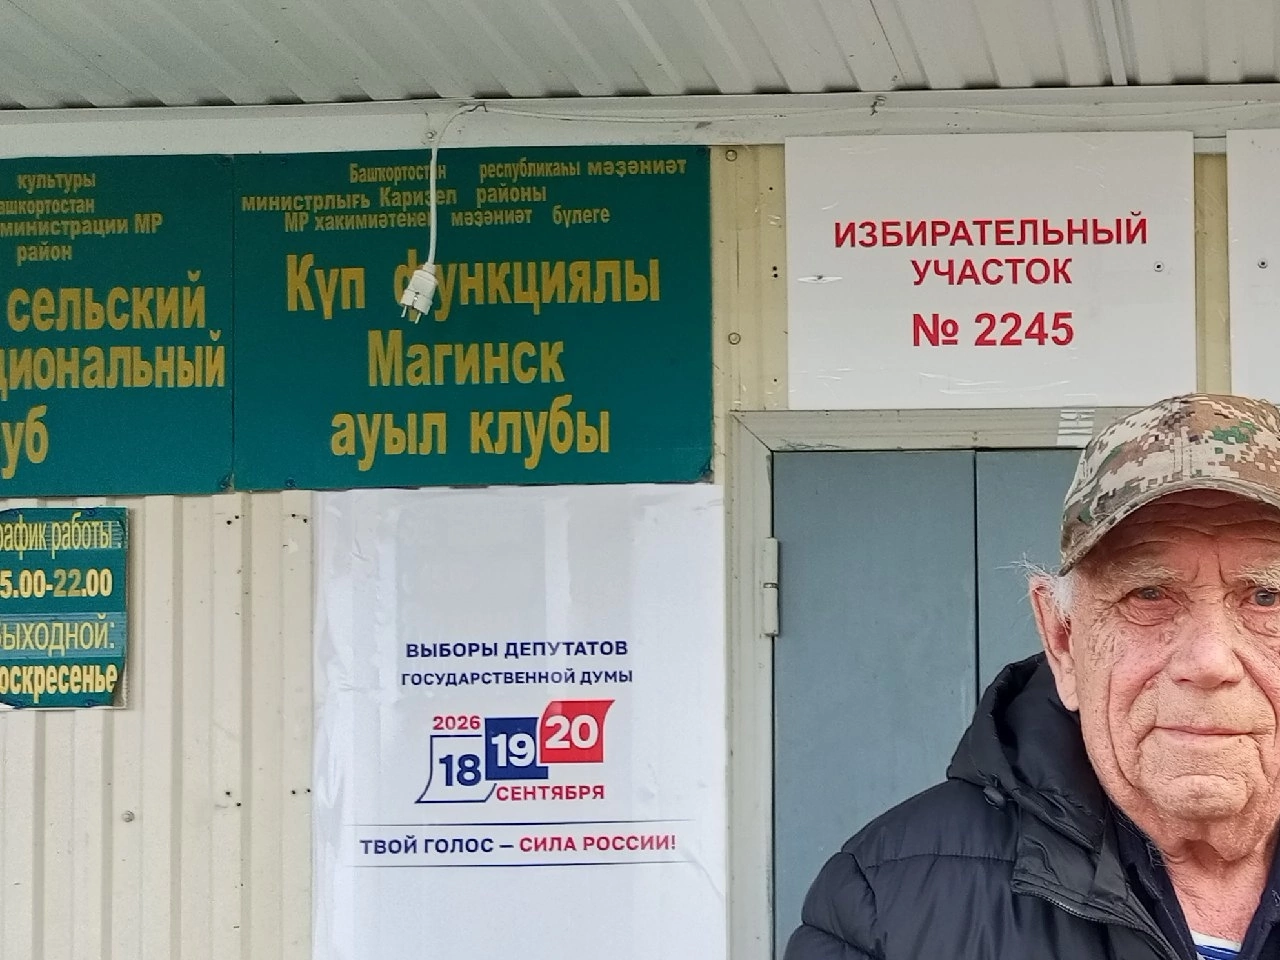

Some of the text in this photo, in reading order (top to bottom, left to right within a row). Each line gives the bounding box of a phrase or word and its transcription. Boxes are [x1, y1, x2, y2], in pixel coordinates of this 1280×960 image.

[18, 172, 96, 194] культуры
[350, 163, 447, 186] Башкортостн
[479, 157, 580, 183] республикаһы
[477, 183, 546, 208] районы
[134, 213, 163, 234] МР
[285, 212, 308, 232] МР
[553, 205, 611, 228] бүлеге
[834, 211, 1148, 248] ИЗБИРАТЕЛЬНЫЙ
[17, 241, 73, 266] район
[286, 254, 365, 320] Күп
[911, 258, 1073, 286] УЧАСТОК
[7, 269, 206, 331] сельский
[912, 312, 1074, 347] № 2245
[368, 330, 564, 387] Магинск
[1, 404, 49, 480] уб
[331, 395, 609, 472] ауыл клубы
[0, 514, 47, 560] афик
[0, 568, 113, 599] 5.00-22.00
[406, 641, 628, 659] ВЫБОРЫ ДЕПУТАТОВ
[401, 669, 633, 687] ГОСУДАРСТВЕННОЙ ДУМЫ
[433, 715, 480, 730] 2026
[545, 715, 598, 749] 20
[491, 733, 536, 767] 19
[439, 754, 481, 787] 18
[496, 785, 605, 801] СЕНТЯБРЯ
[360, 834, 418, 855] ТВОЙ
[424, 838, 494, 854] ГОЛОС
[519, 837, 576, 852] СИЛА
[583, 835, 676, 852] РОССИИ!
